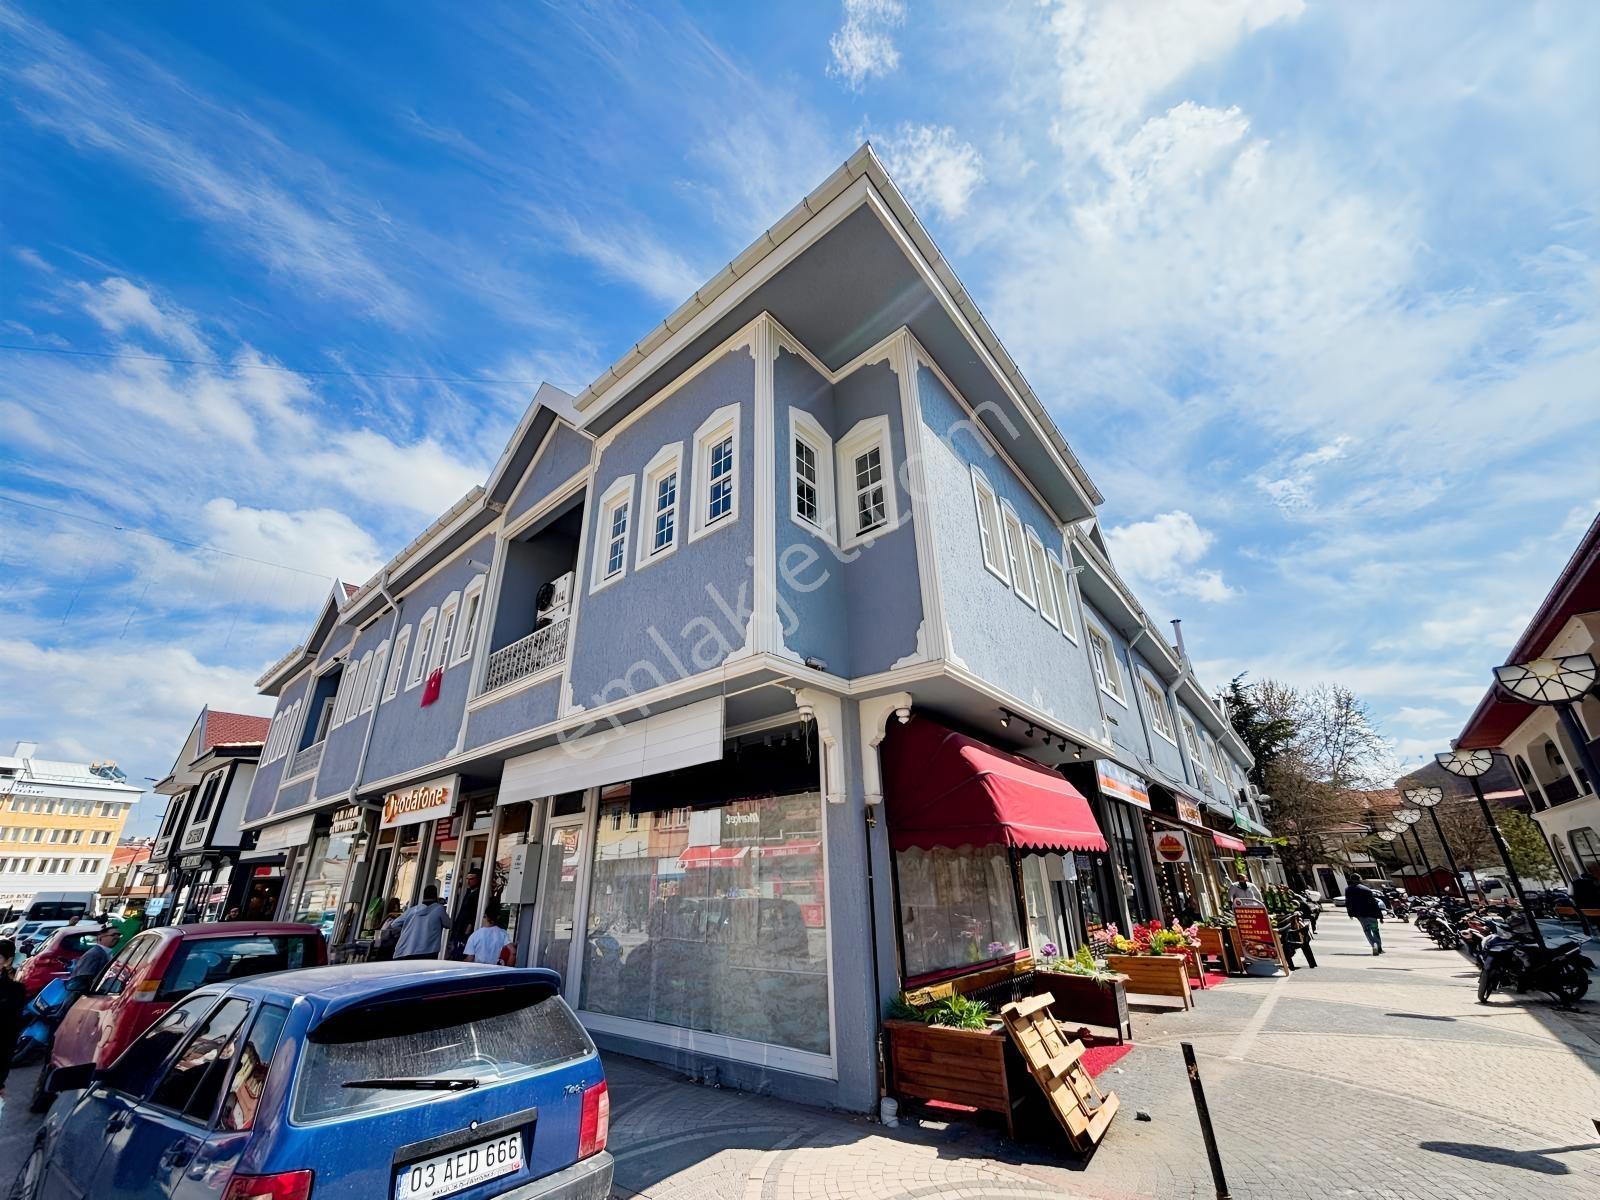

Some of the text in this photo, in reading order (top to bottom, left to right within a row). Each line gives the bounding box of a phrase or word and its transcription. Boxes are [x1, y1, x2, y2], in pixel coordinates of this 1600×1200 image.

[394, 786, 445, 815] vodafone
[411, 1163, 436, 1192] 03
[443, 1149, 479, 1183] AED
[486, 1136, 518, 1167] 666
